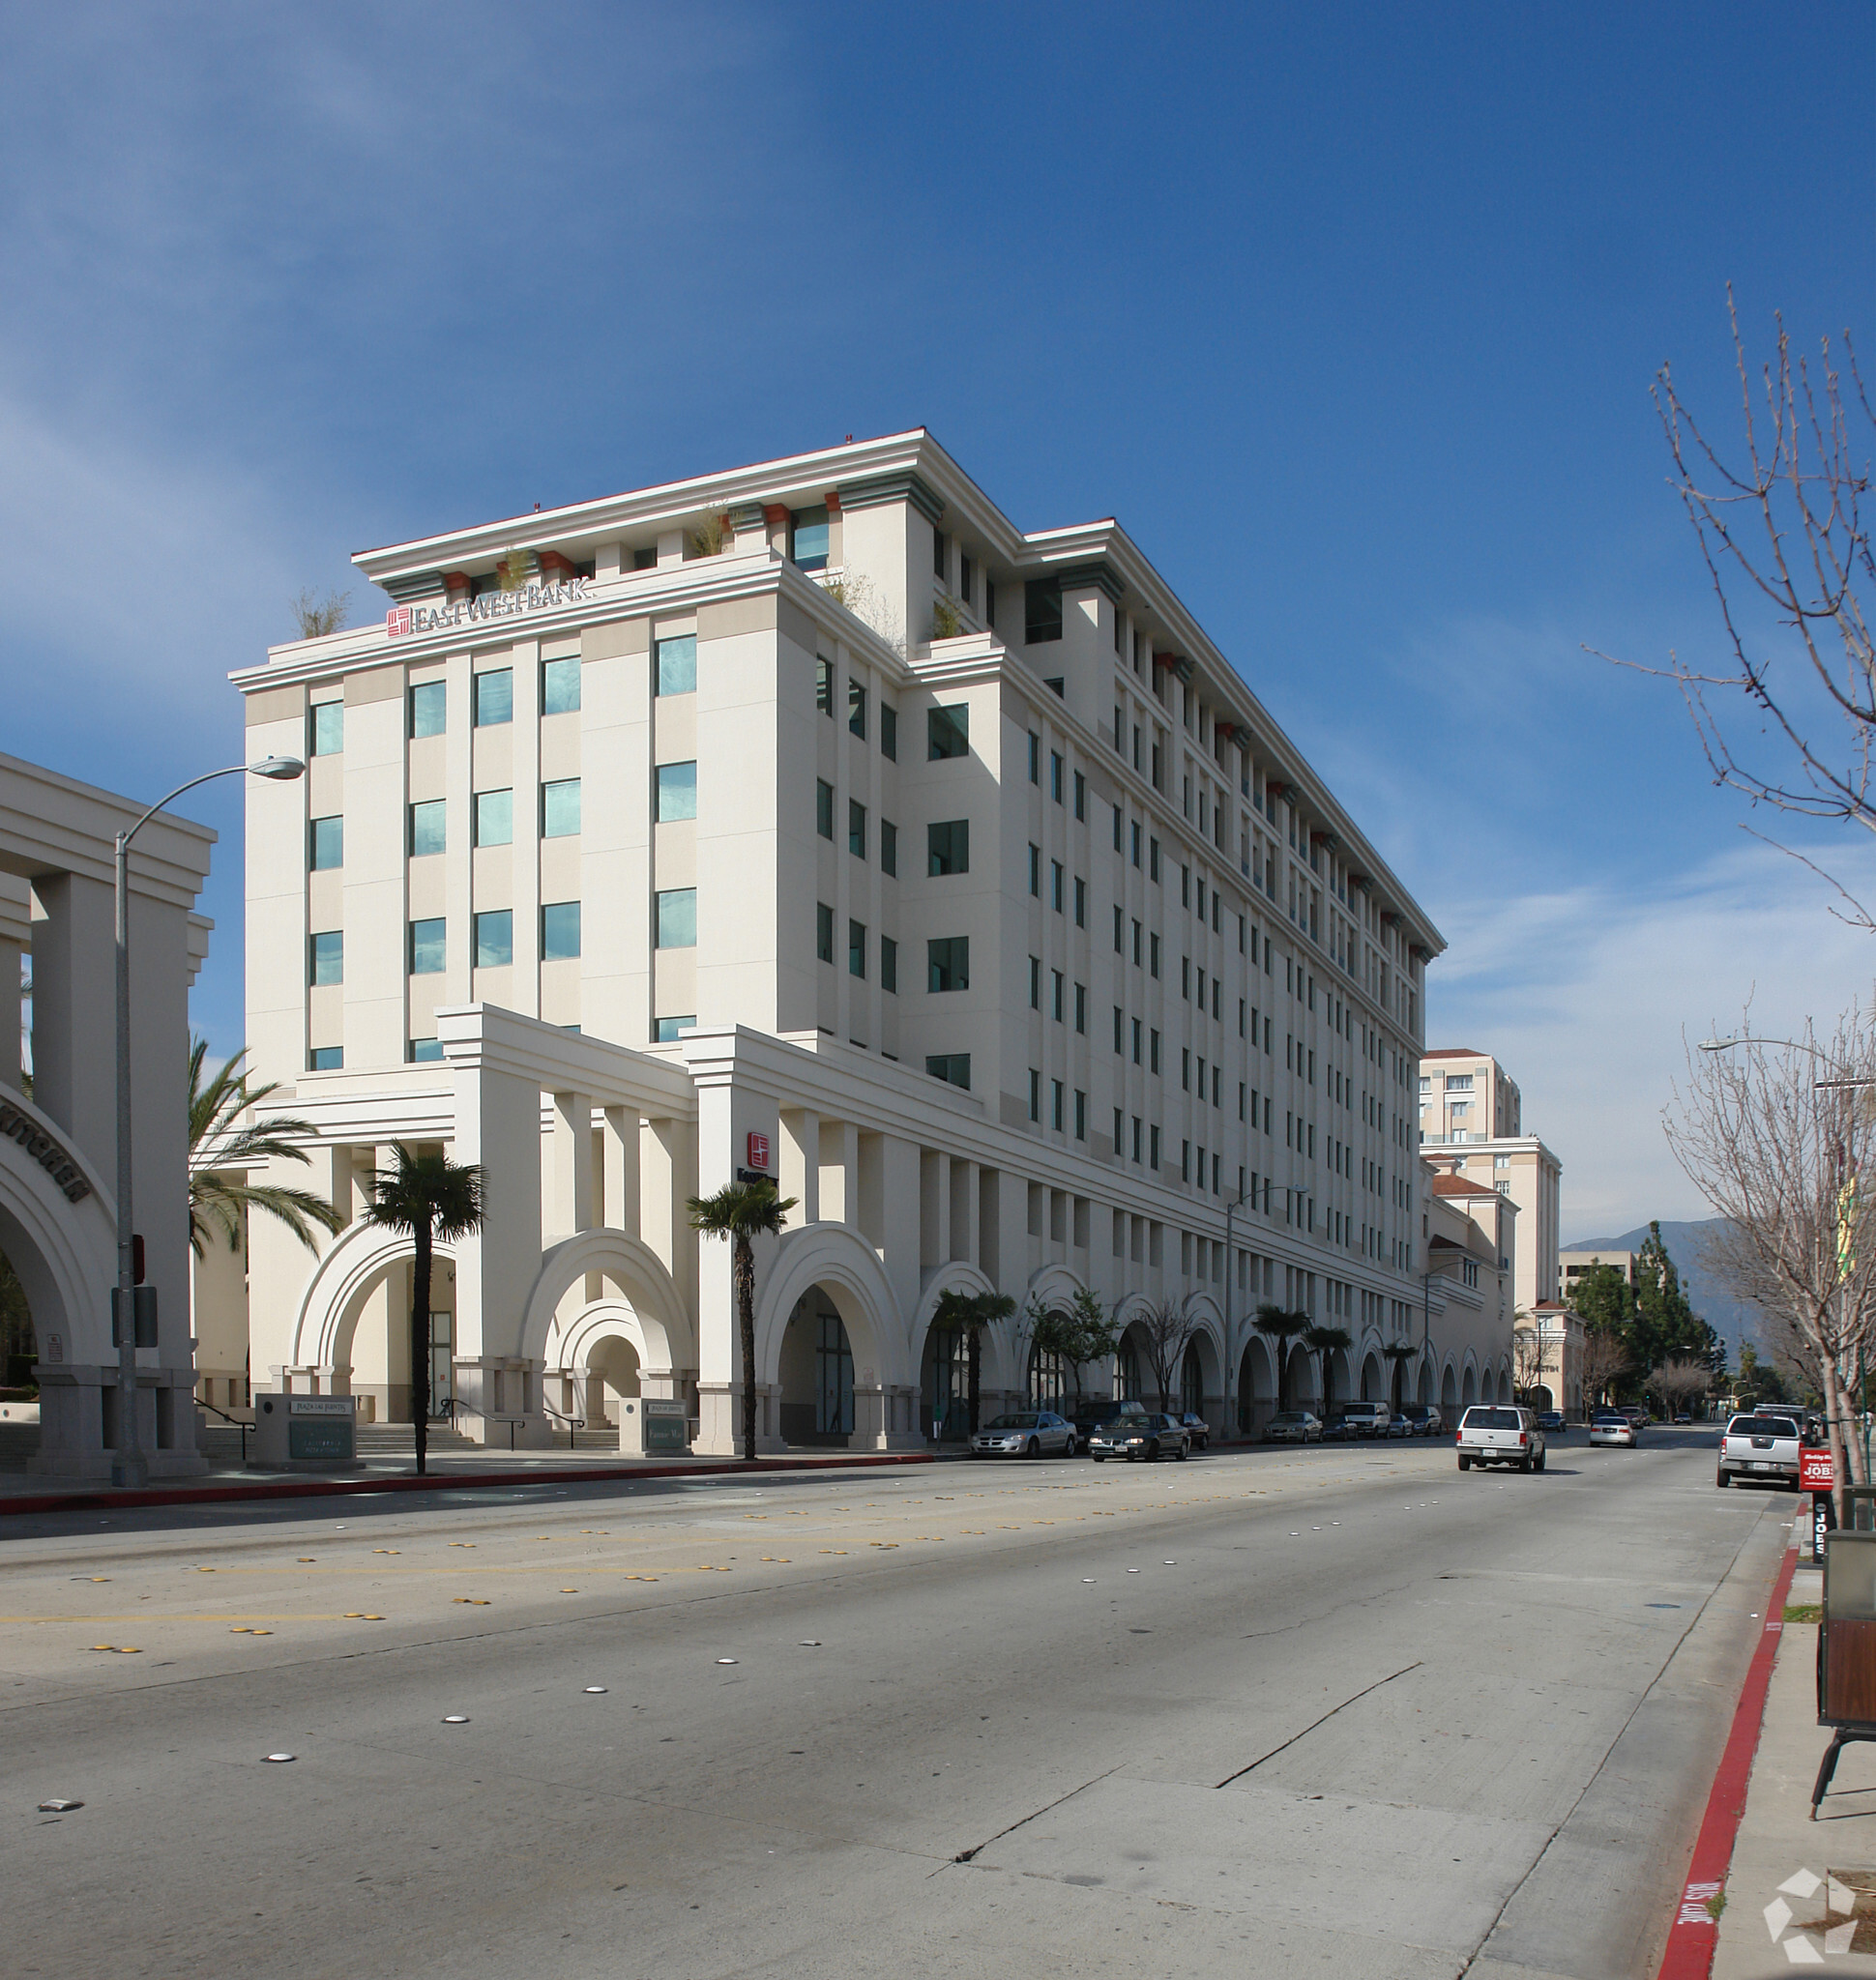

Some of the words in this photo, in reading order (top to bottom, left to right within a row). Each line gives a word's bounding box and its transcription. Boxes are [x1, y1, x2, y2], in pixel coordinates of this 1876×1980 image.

[414, 597, 464, 633] EAST
[465, 588, 527, 622] WEST
[526, 575, 592, 610] BANK
[1815, 1513, 1828, 1555] JOBS
[1685, 1882, 1720, 1900] BUS
[1677, 1904, 1714, 1924] ZONE
